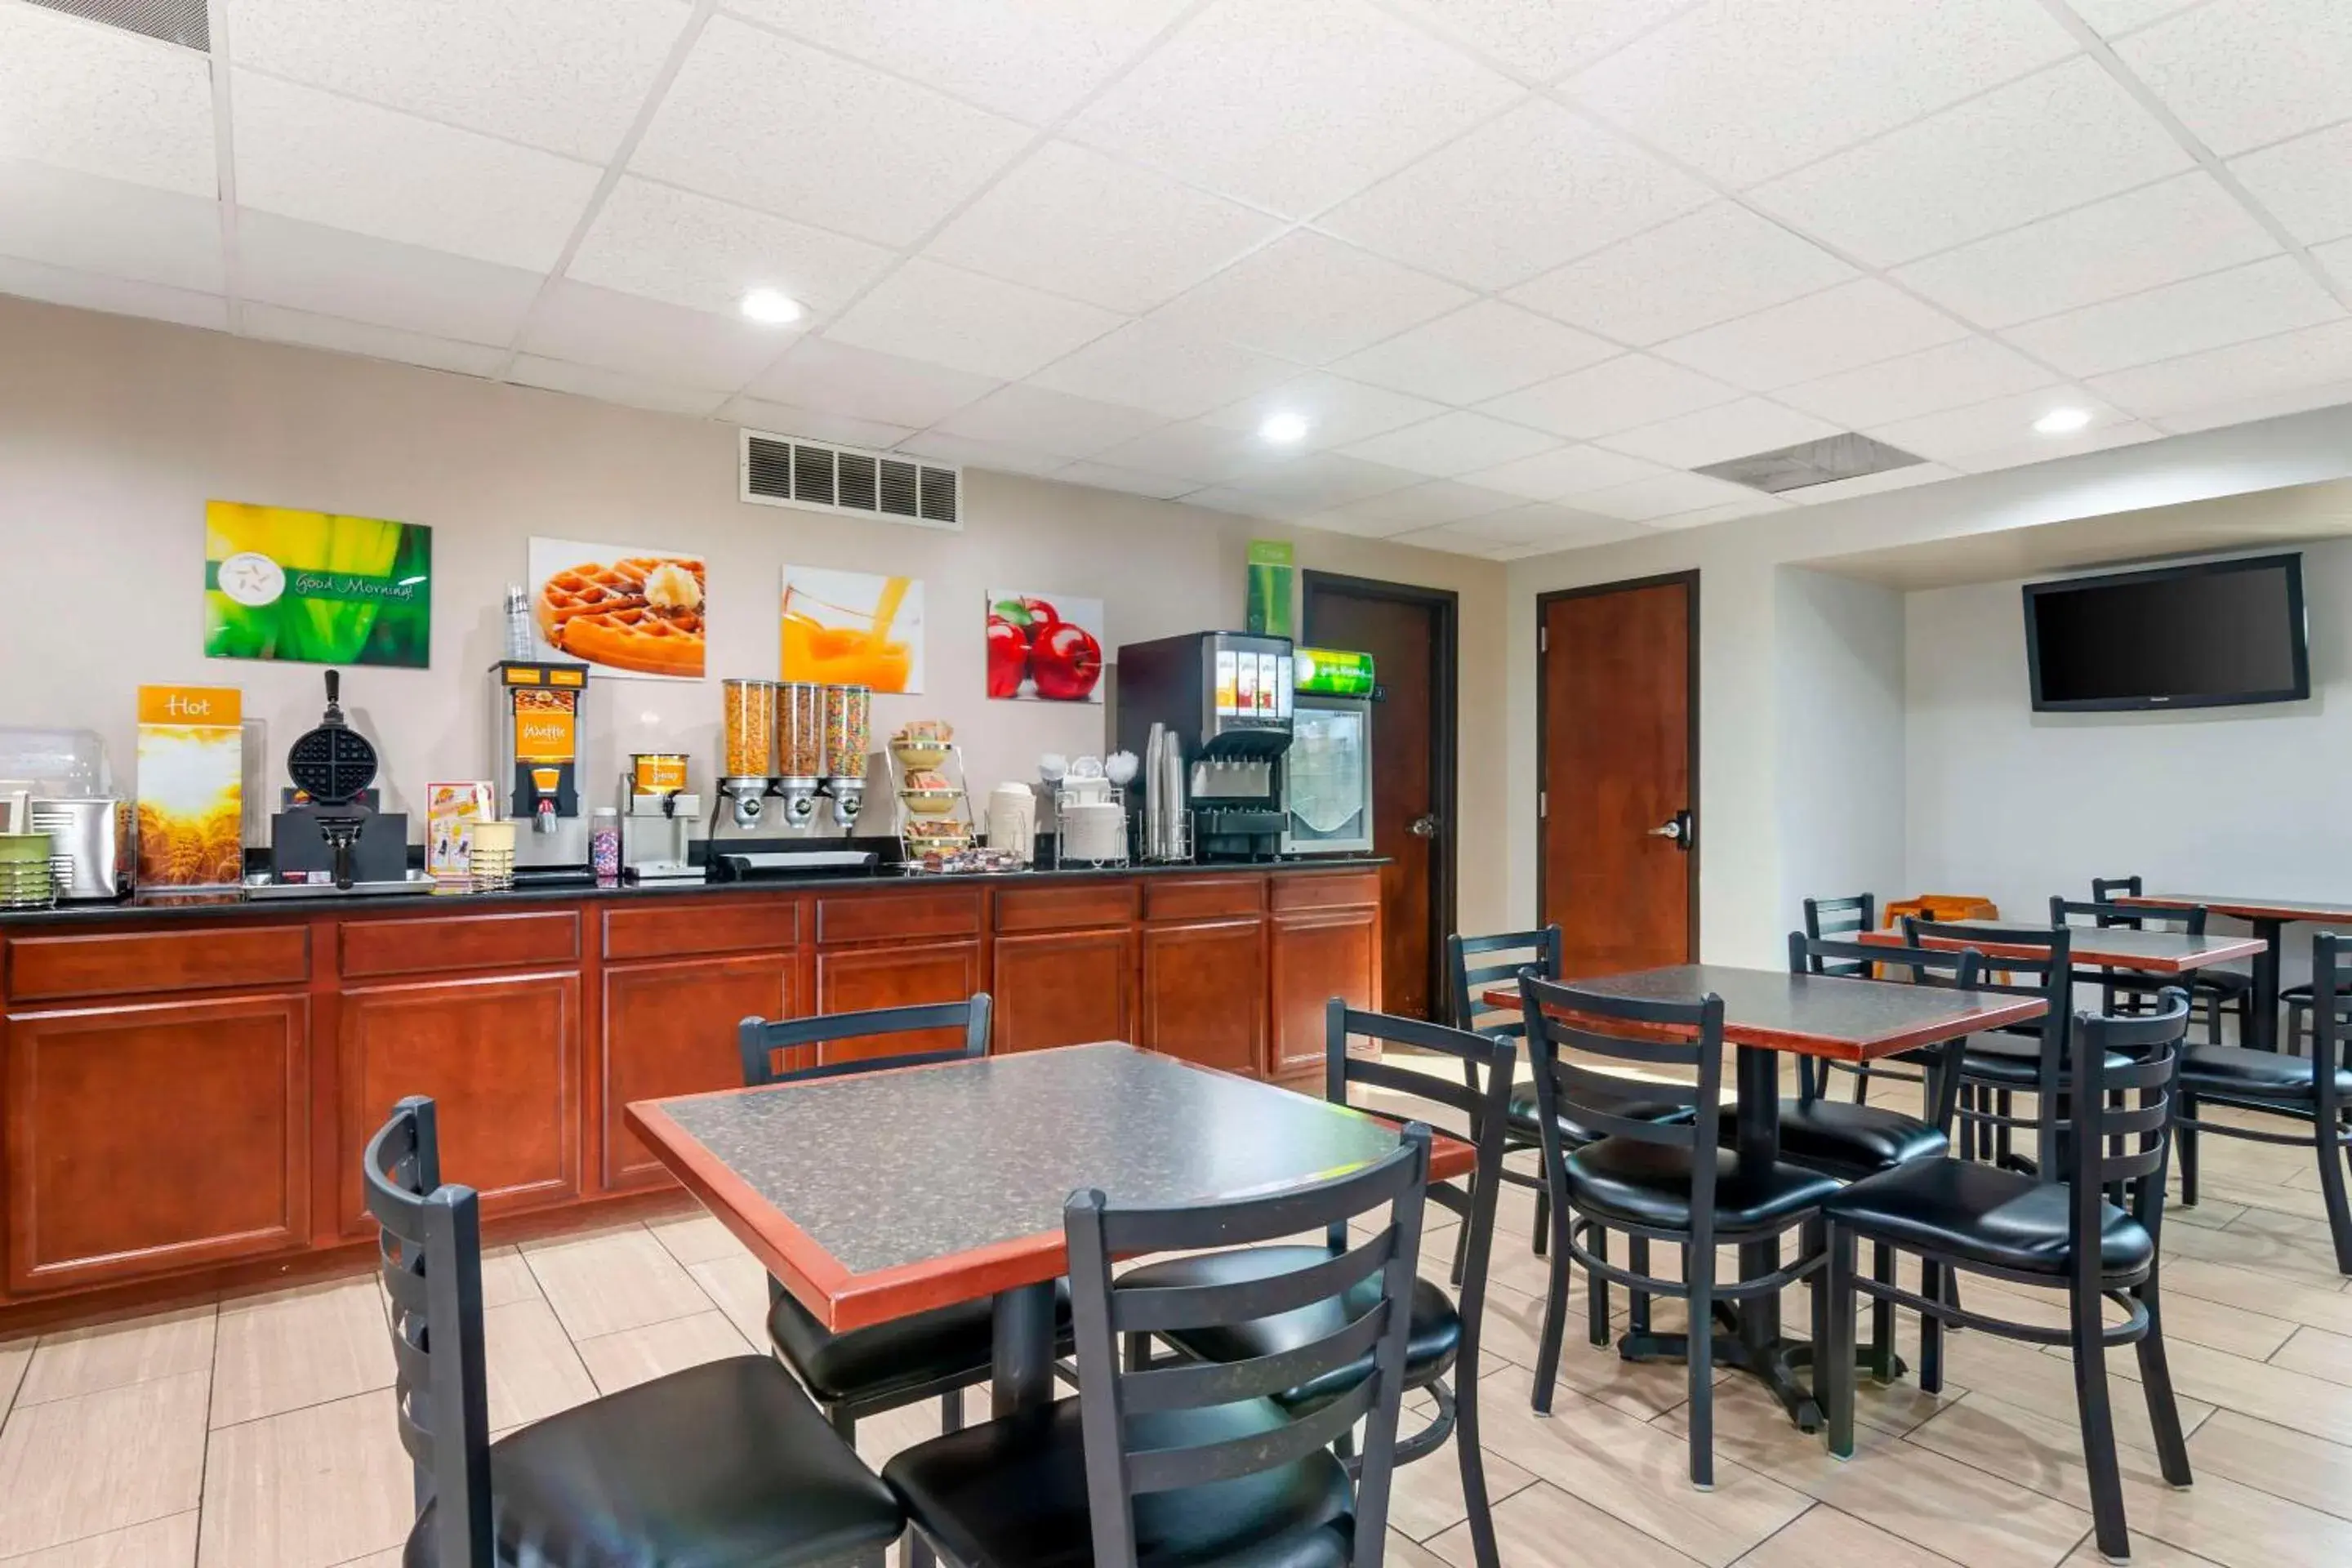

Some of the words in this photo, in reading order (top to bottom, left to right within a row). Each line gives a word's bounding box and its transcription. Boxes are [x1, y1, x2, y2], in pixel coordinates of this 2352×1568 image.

[296, 573, 333, 594] Good
[336, 578, 413, 601] Morning!
[163, 693, 212, 716] Hot
